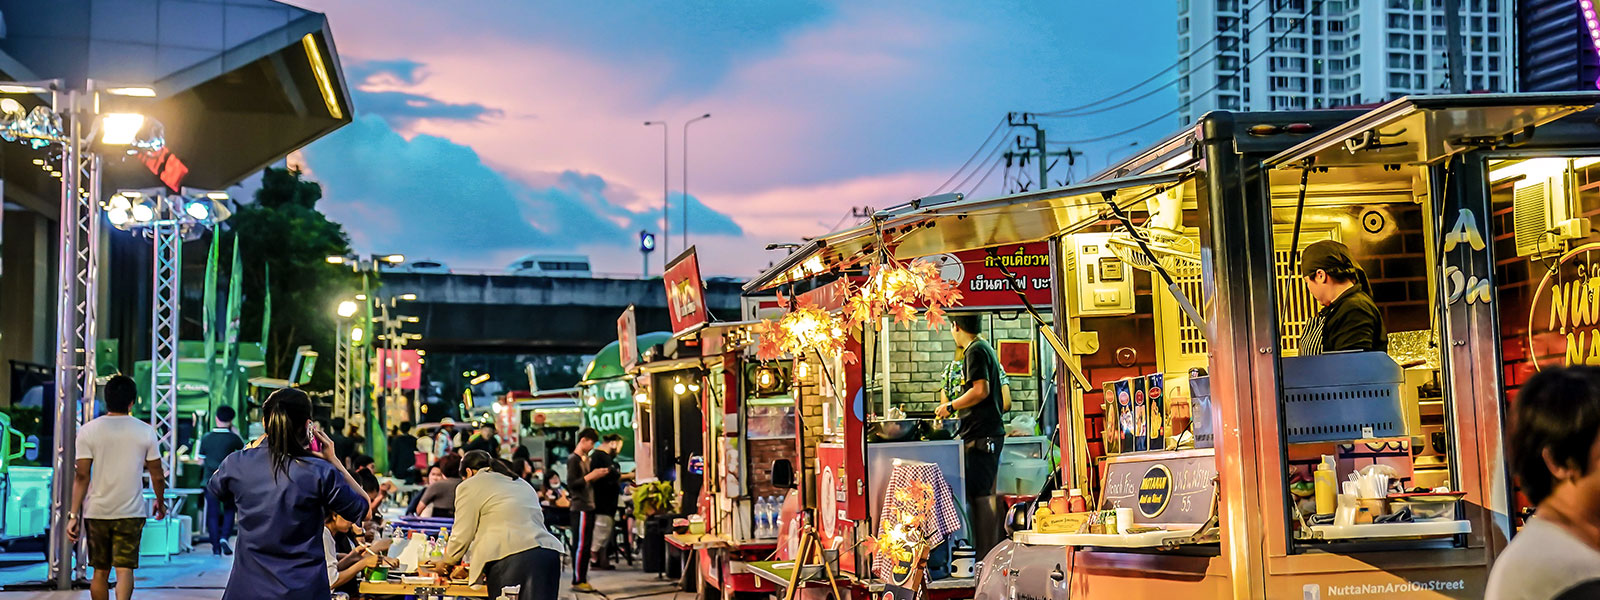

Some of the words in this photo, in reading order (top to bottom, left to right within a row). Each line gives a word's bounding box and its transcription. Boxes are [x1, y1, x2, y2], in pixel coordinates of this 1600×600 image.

[1444, 208, 1486, 252] A
[1032, 278, 1052, 289] บะ
[582, 407, 634, 432] han
[1328, 579, 1464, 596] NuttaNanAroiOnStreet
